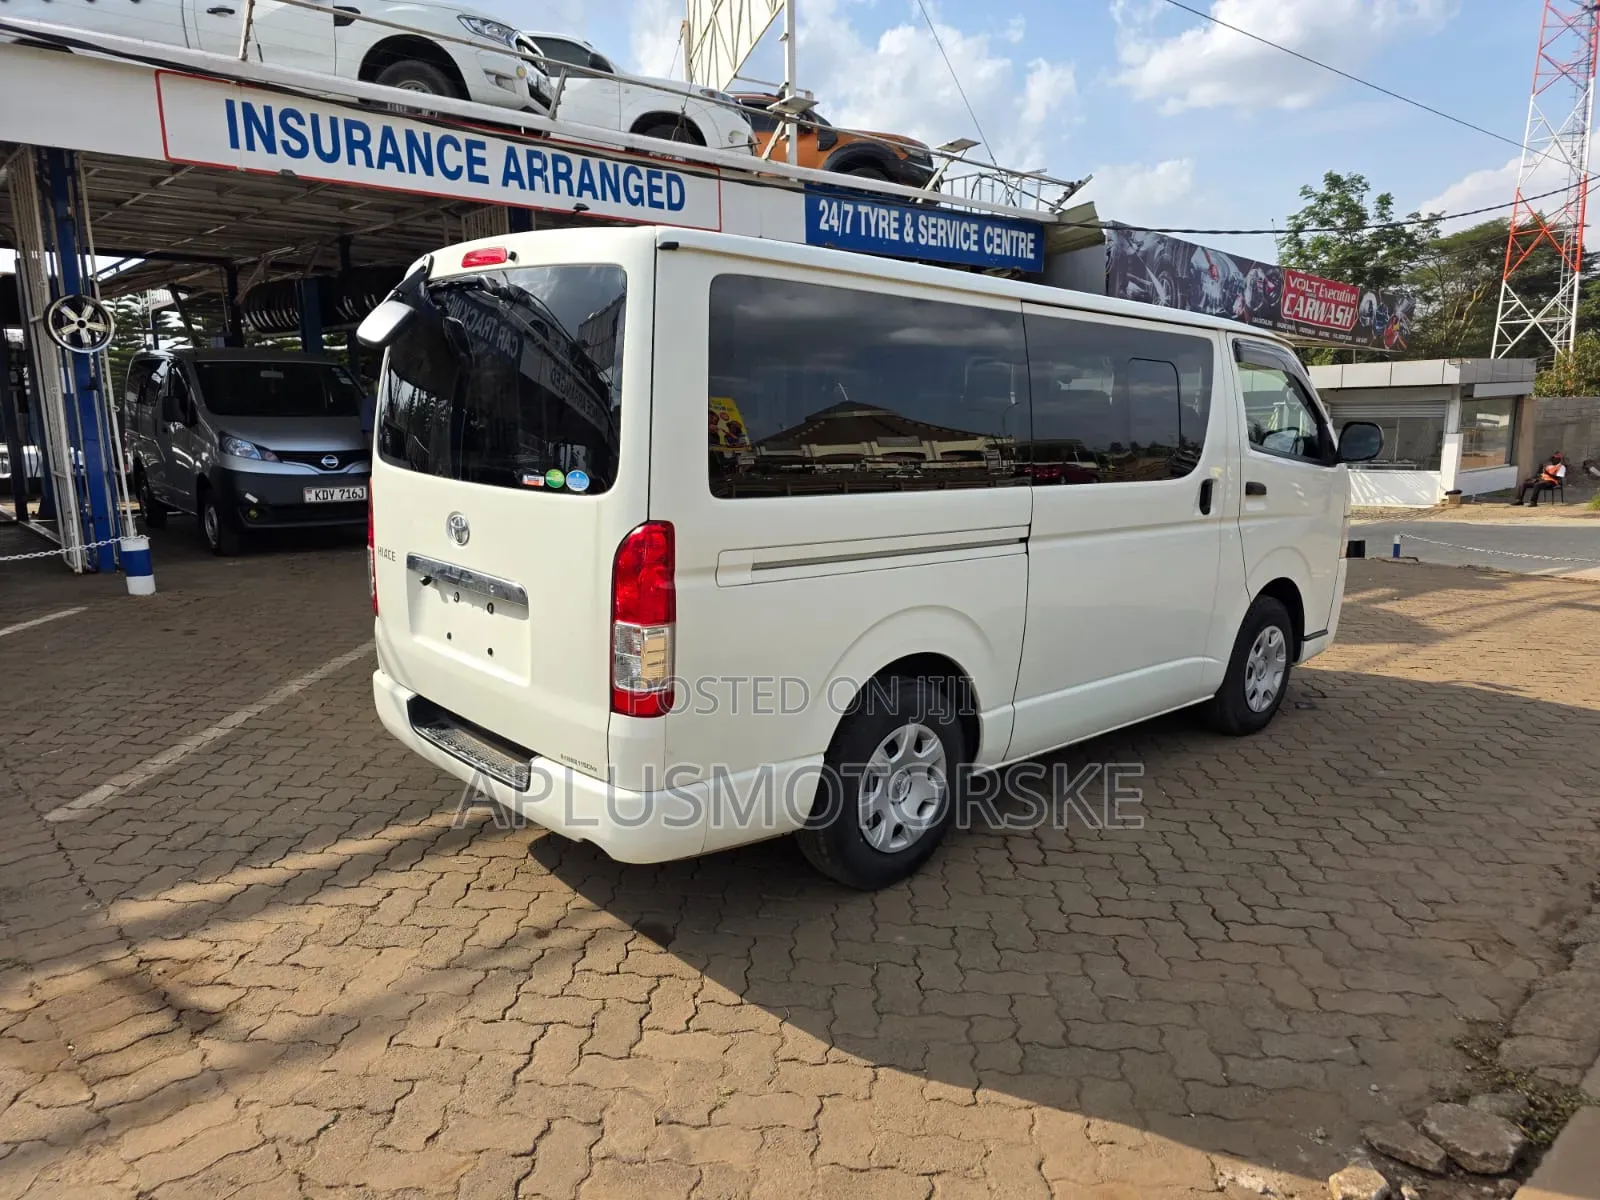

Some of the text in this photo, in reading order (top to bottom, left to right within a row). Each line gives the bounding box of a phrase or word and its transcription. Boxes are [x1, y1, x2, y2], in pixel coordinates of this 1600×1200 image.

[225, 98, 686, 212] INSURANCE ARRANGED
[819, 199, 1035, 260] 24/7 TYRE & SERVICE CENTRE
[1288, 275, 1320, 294] VOLT
[1283, 293, 1355, 328] CARWASH
[315, 488, 364, 501] KDY 716J
[377, 545, 397, 562] HIACE
